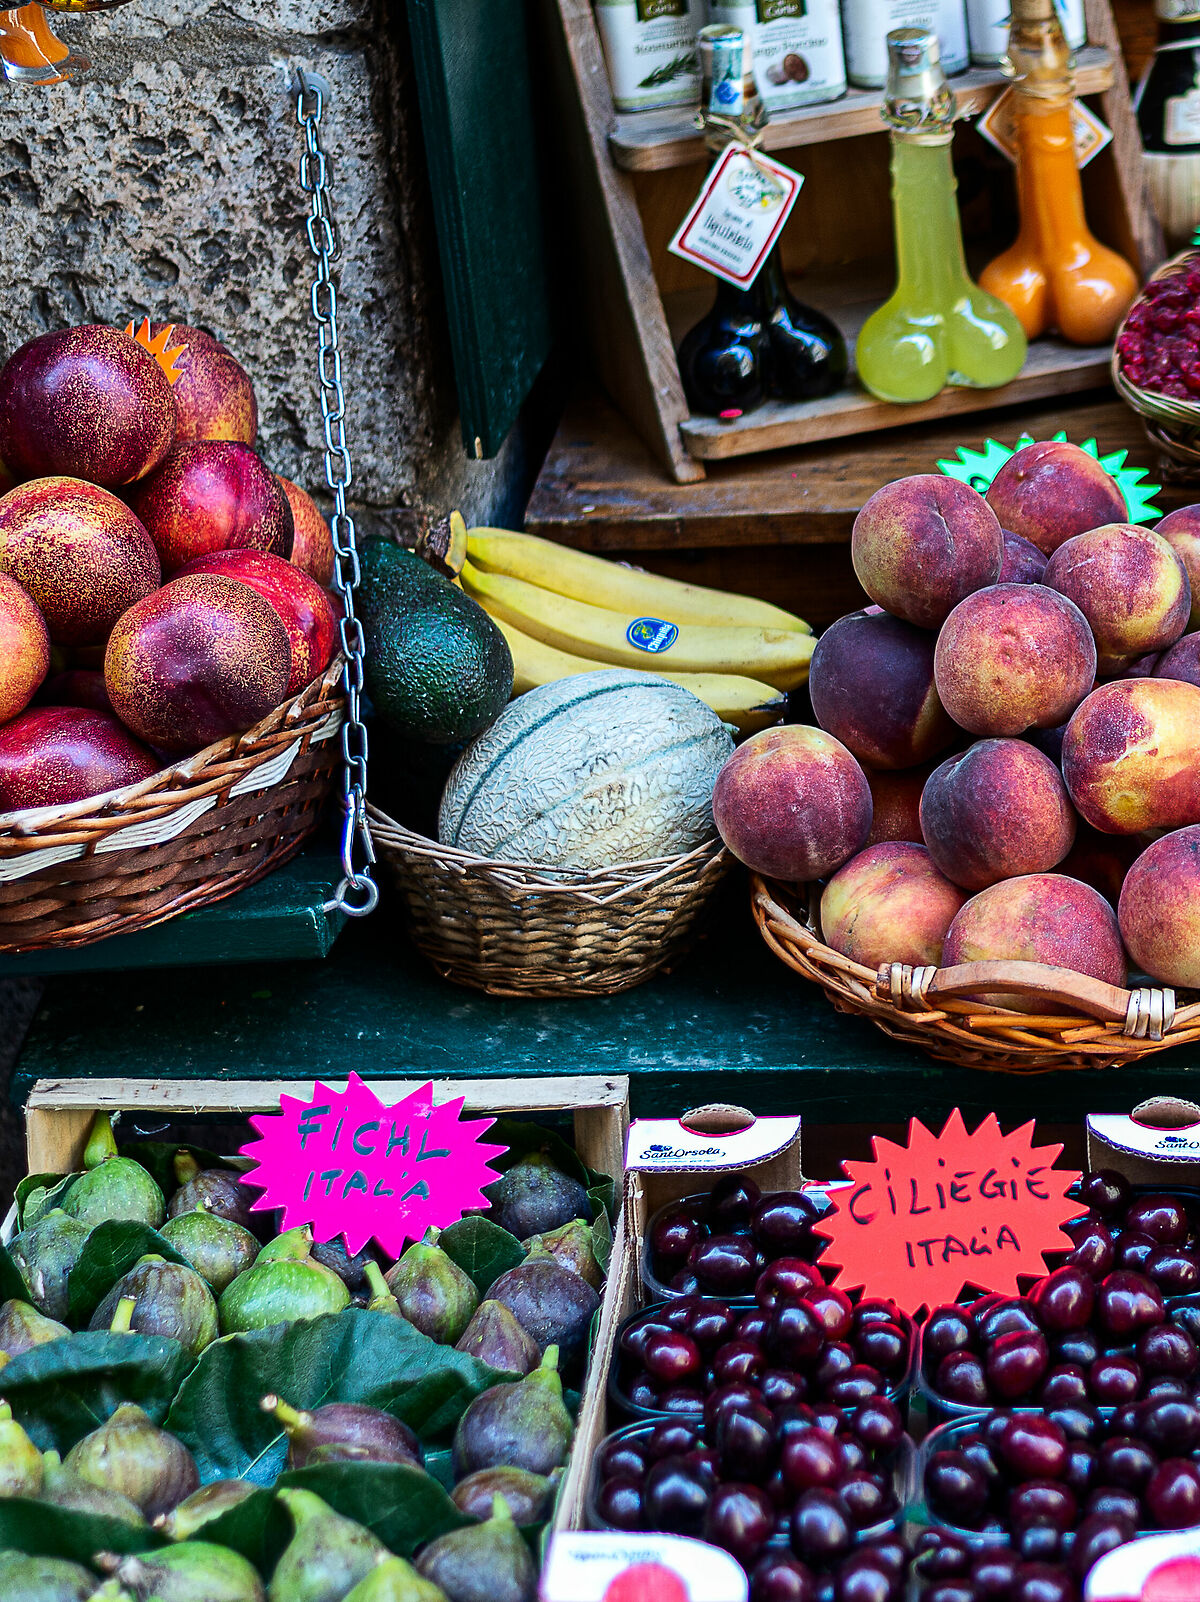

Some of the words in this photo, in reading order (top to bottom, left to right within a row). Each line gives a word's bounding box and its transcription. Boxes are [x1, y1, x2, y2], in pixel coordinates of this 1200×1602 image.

[303, 1169, 430, 1202] ITALIA
[849, 1157, 1050, 1226] CILIEGIE
[905, 1224, 1021, 1268] ITALIA
